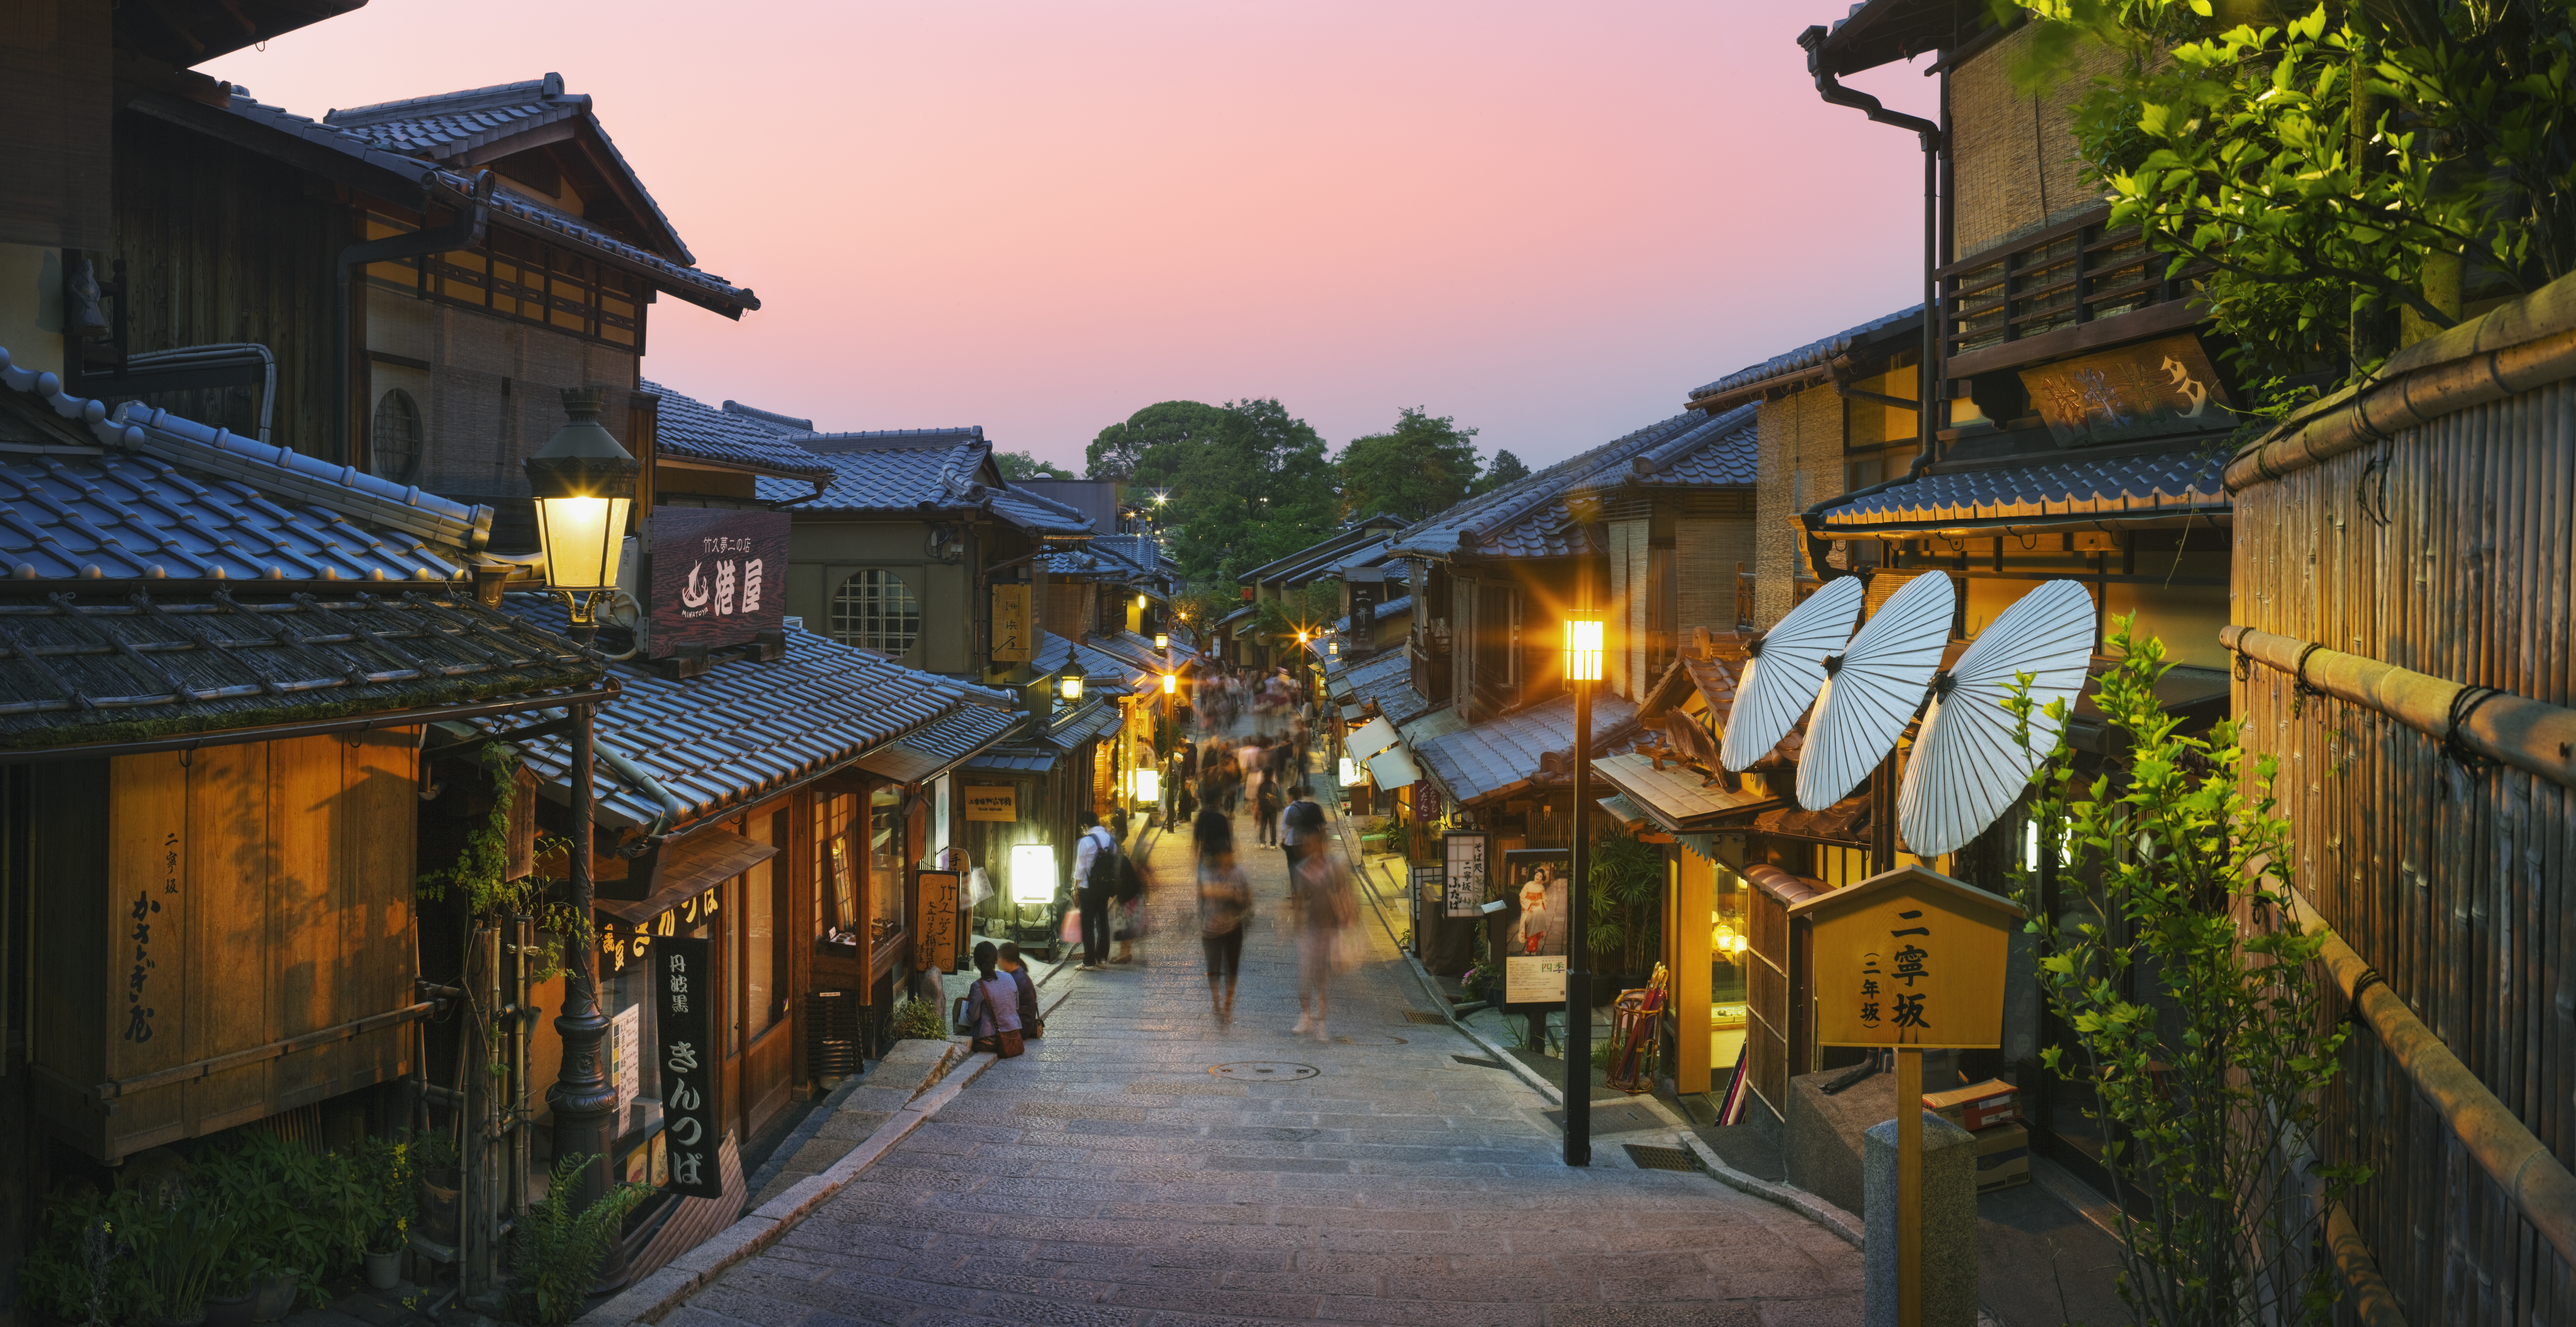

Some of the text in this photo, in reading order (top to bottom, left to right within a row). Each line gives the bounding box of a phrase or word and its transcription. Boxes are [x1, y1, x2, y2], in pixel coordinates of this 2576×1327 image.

[703, 536, 751, 553] 竹久夢二の店
[715, 558, 762, 617] 港屋
[682, 607, 708, 618] MINATOYA
[1420, 791, 1429, 817] だんご
[164, 832, 179, 894] 二寧坂
[1474, 843, 1483, 873] そば処
[1448, 877, 1461, 910] ふたば
[1462, 862, 1472, 892] 二寧坂
[937, 884, 957, 946] 竹久夢二
[1542, 962, 1565, 973] 四季
[1890, 910, 1930, 1028] 二寧坂
[1860, 952, 1881, 1029] （二年坂）
[668, 954, 703, 1186] 丹波黒 きんつば
